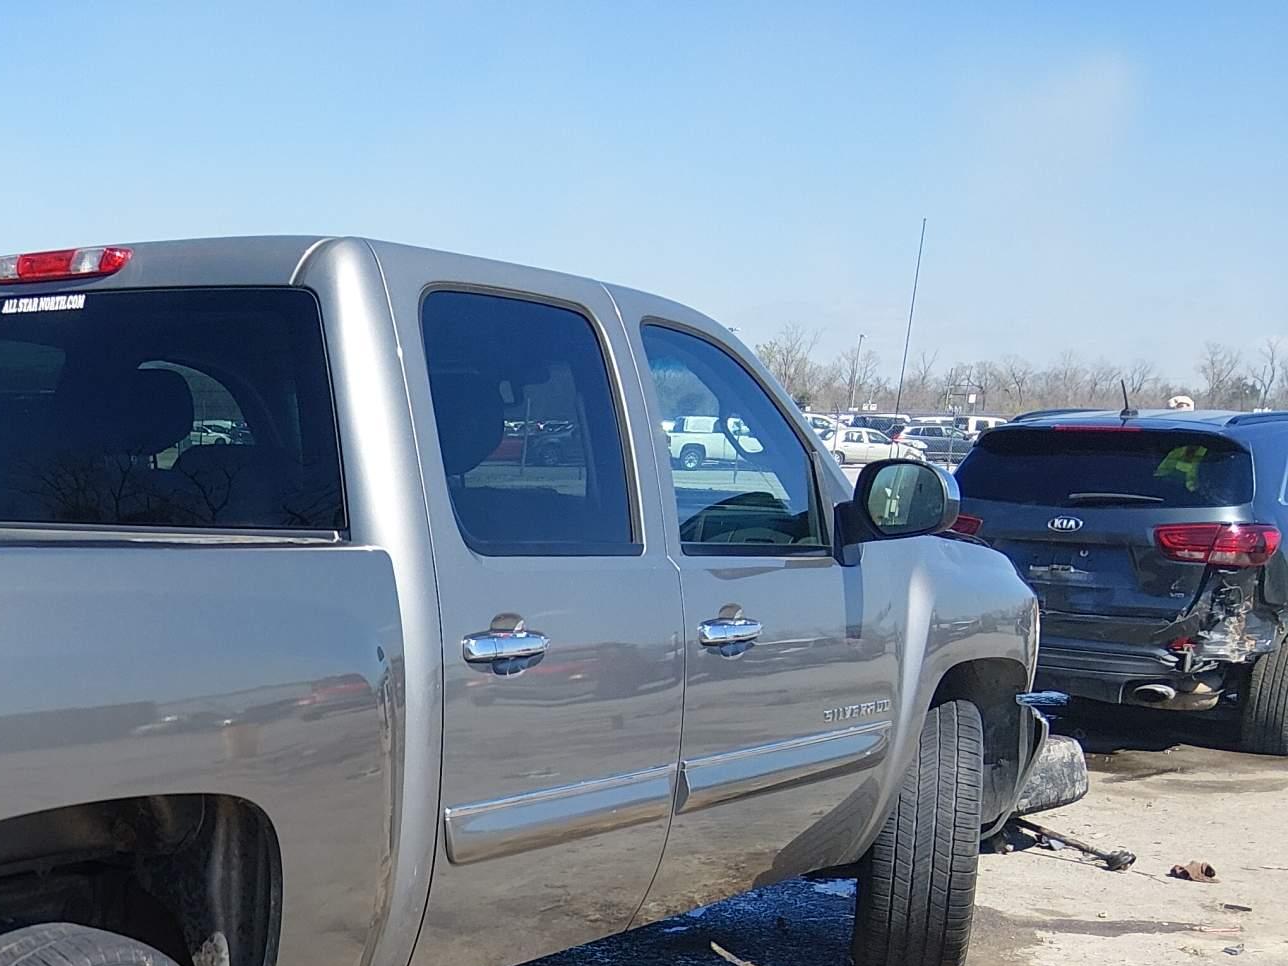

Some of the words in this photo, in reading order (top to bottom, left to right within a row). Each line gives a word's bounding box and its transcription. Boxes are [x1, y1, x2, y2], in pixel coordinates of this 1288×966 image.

[1, 299, 18, 314] ALL
[17, 297, 39, 313] STAR
[1053, 518, 1076, 529] KIA
[824, 700, 890, 722] SILVERADO
